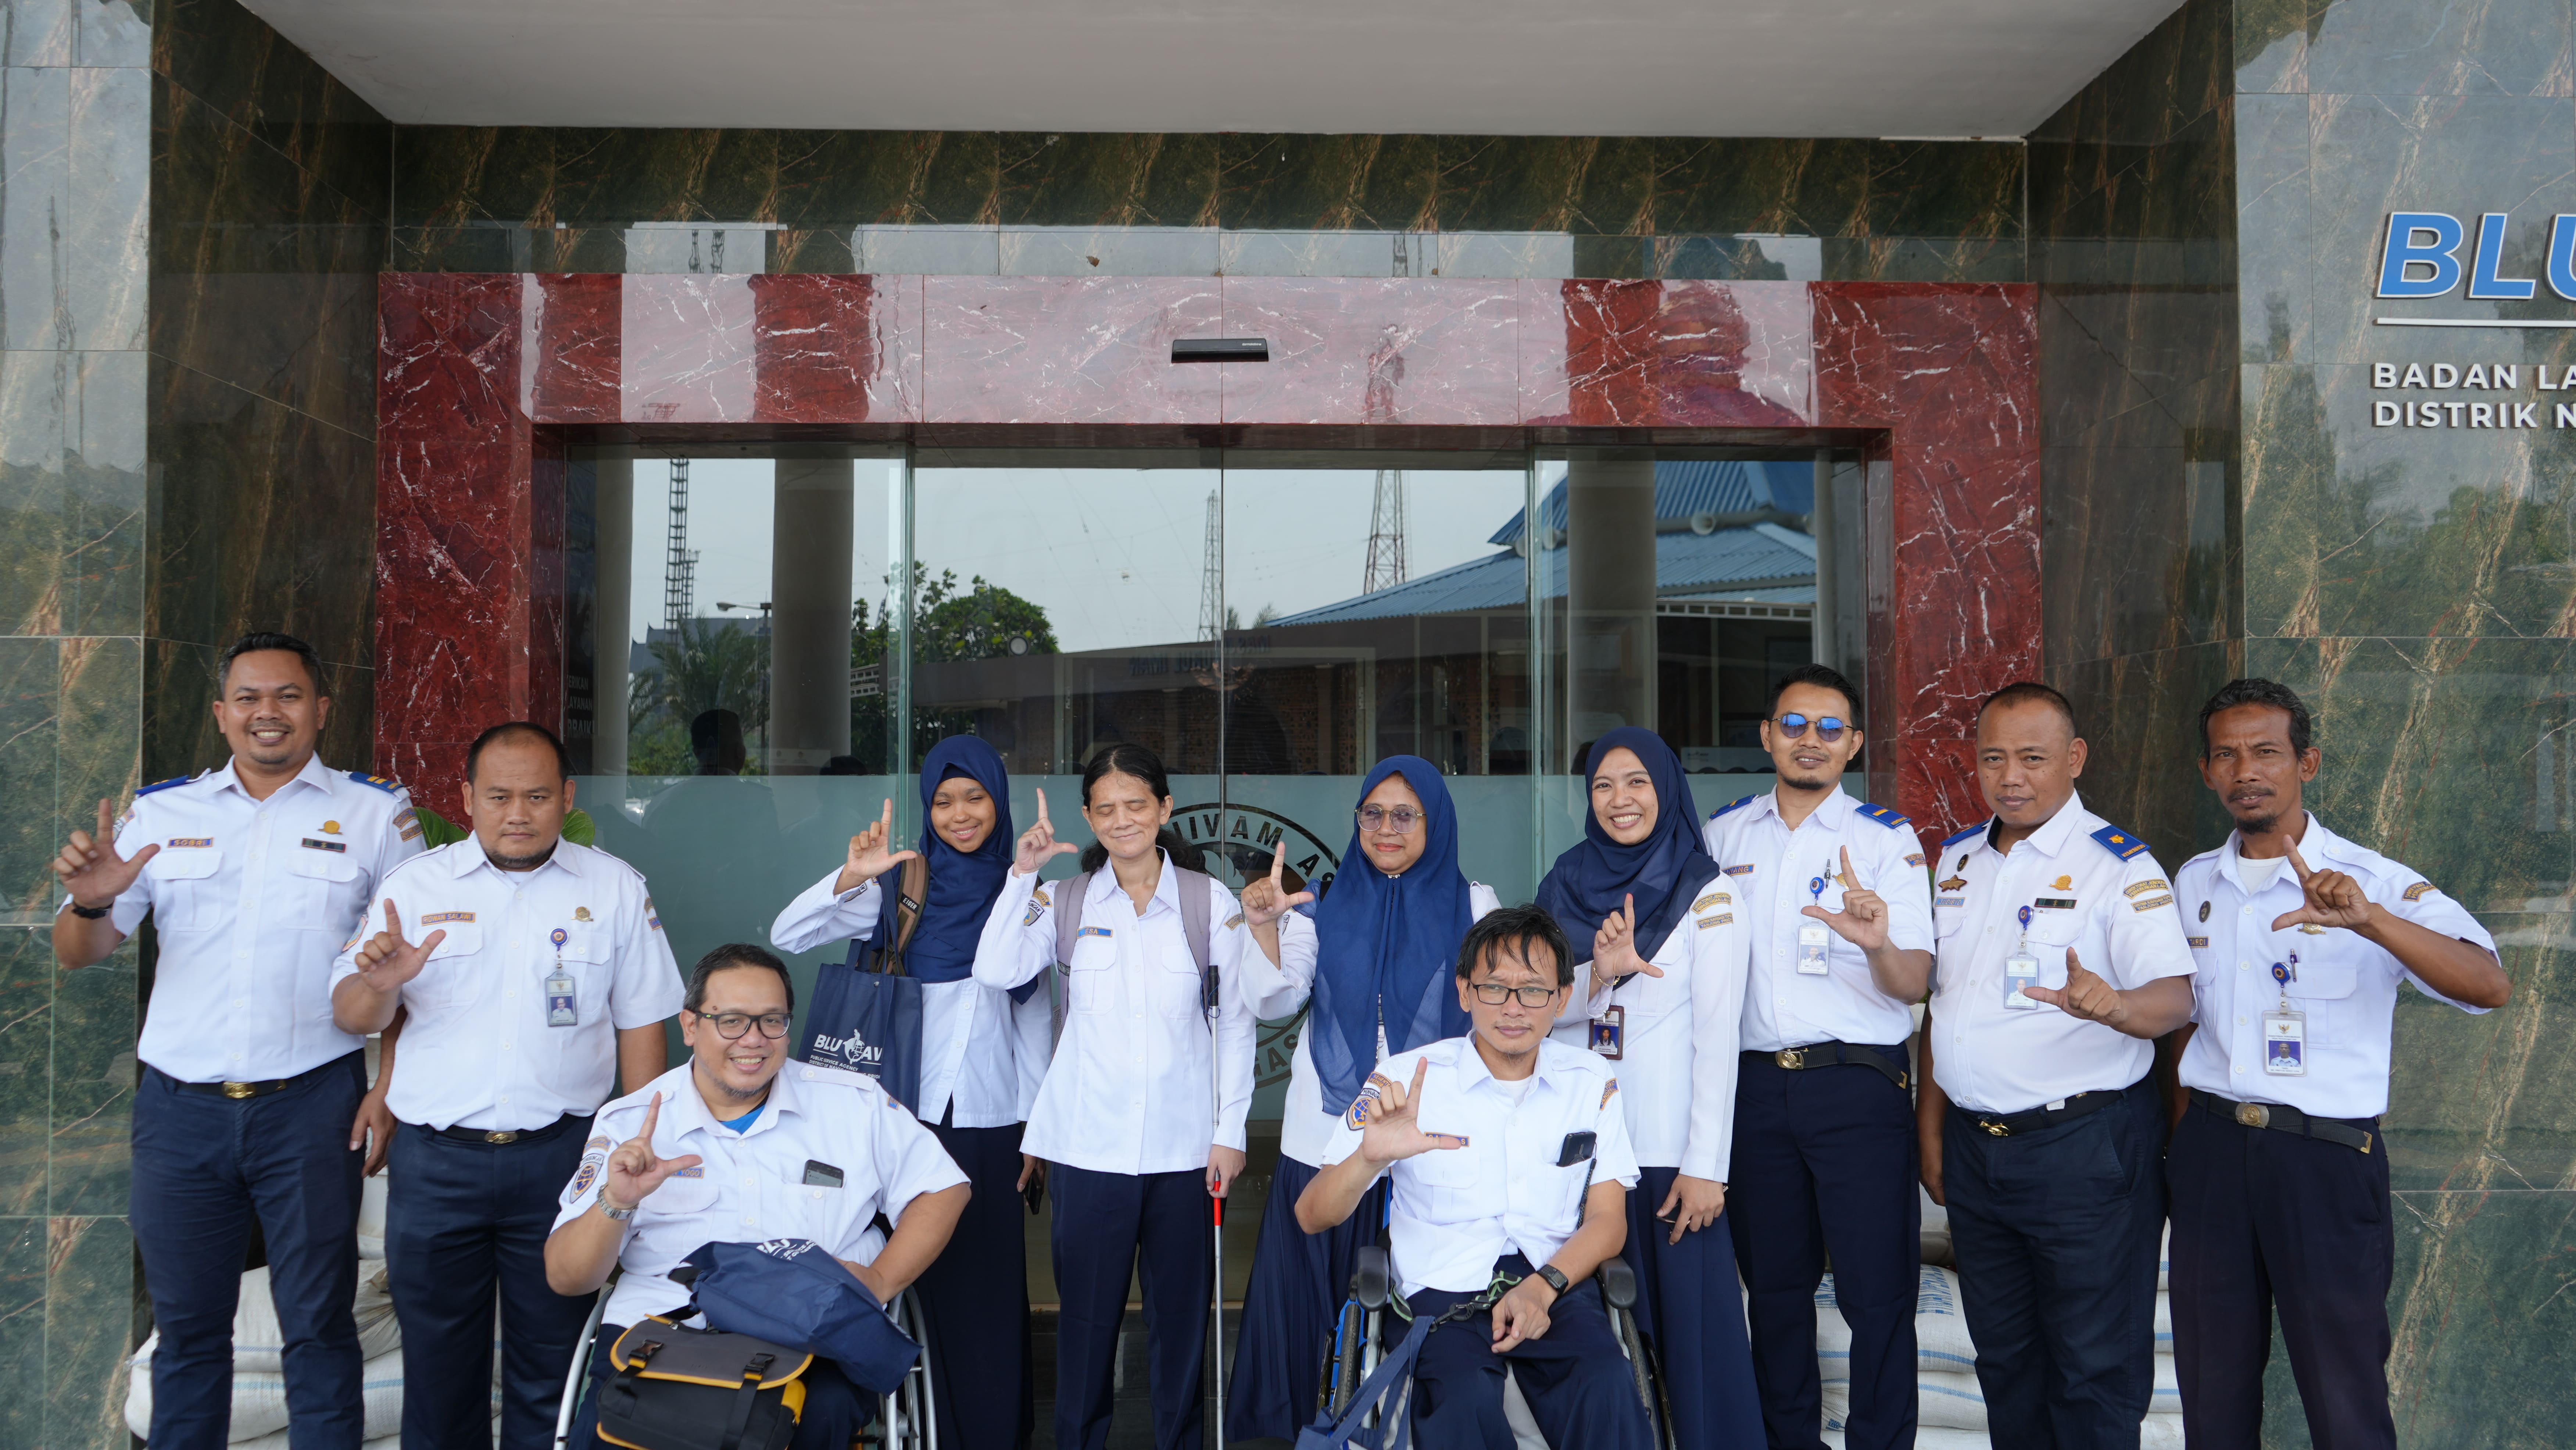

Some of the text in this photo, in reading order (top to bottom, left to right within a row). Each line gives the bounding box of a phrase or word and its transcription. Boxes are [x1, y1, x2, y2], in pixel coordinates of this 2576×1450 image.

[2372, 362, 2517, 389] BADAN
[2373, 401, 2537, 428] DISTRIK
[903, 897, 917, 910] EIGER
[814, 1034, 843, 1052] BLU
[839, 1062, 859, 1071] AGENCY
